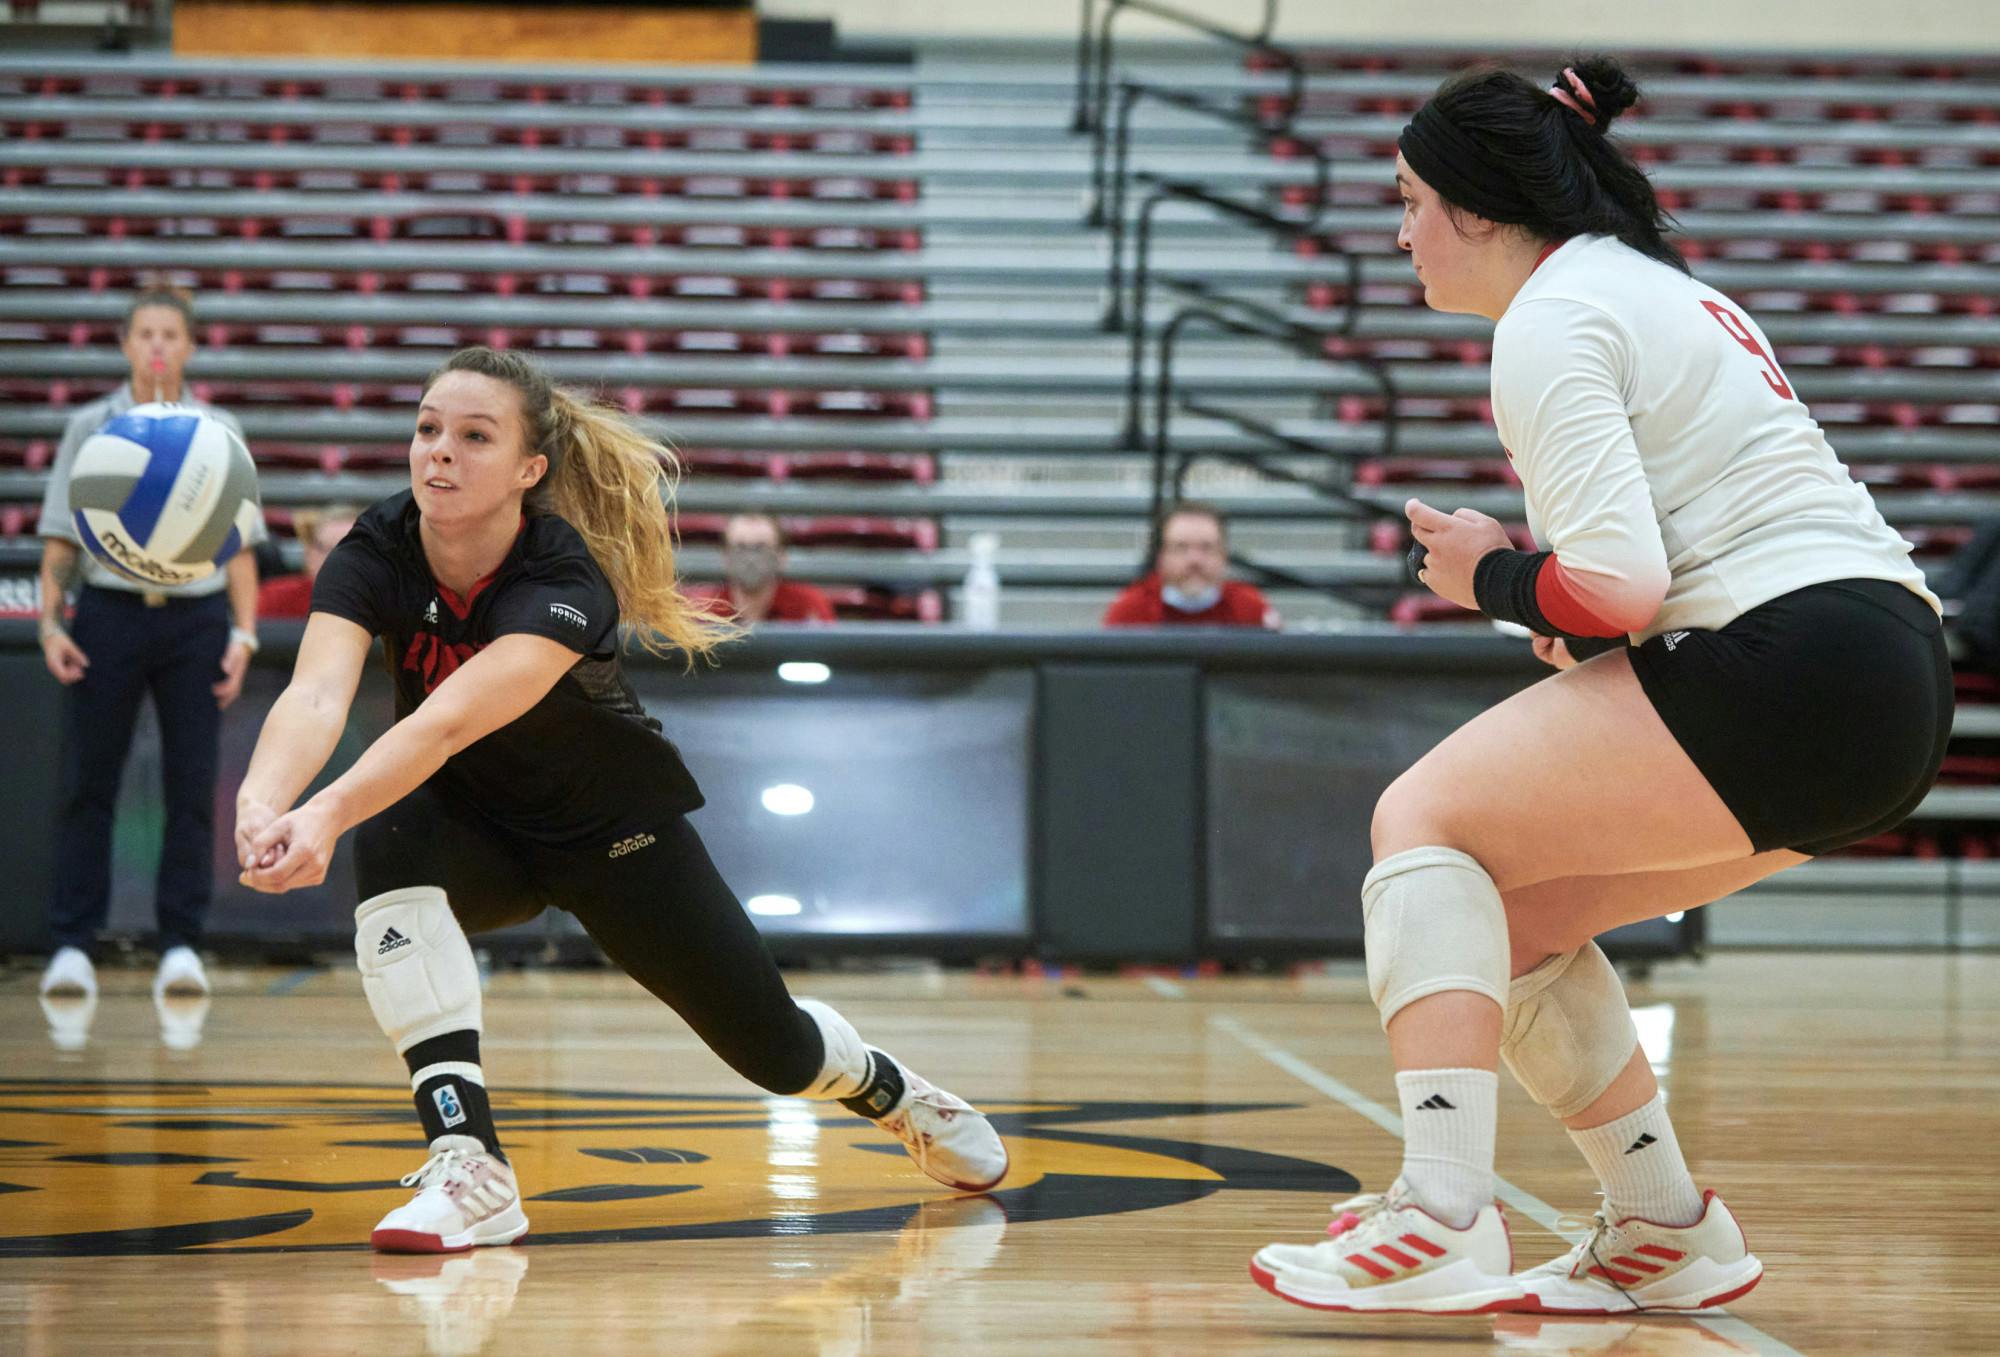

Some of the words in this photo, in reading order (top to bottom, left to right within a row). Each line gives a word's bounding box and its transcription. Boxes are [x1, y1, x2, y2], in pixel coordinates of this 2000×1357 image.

[1699, 300, 1793, 400] 9
[550, 606, 587, 627] HORIZON
[608, 834, 656, 858] adidas
[378, 938, 411, 955] adidas
